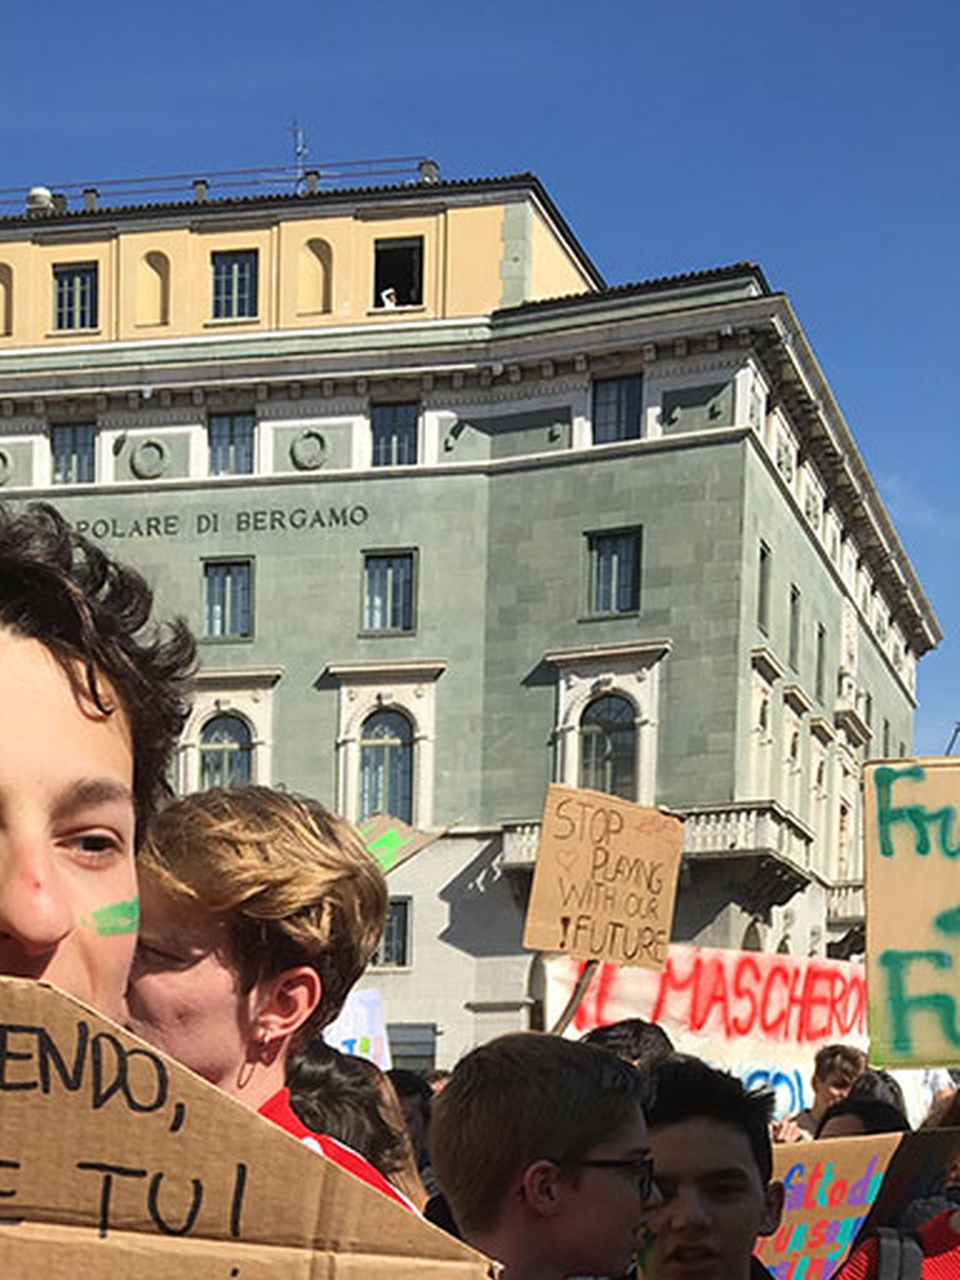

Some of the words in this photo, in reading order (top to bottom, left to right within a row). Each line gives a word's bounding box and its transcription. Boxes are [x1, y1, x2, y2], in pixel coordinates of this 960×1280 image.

[197, 513, 219, 535] DI
[236, 505, 369, 533] BERGAMO
[553, 797, 624, 845] STOP
[558, 876, 617, 911] WITH
[624, 892, 660, 920] OUR
[76, 1161, 248, 1279] TU!
